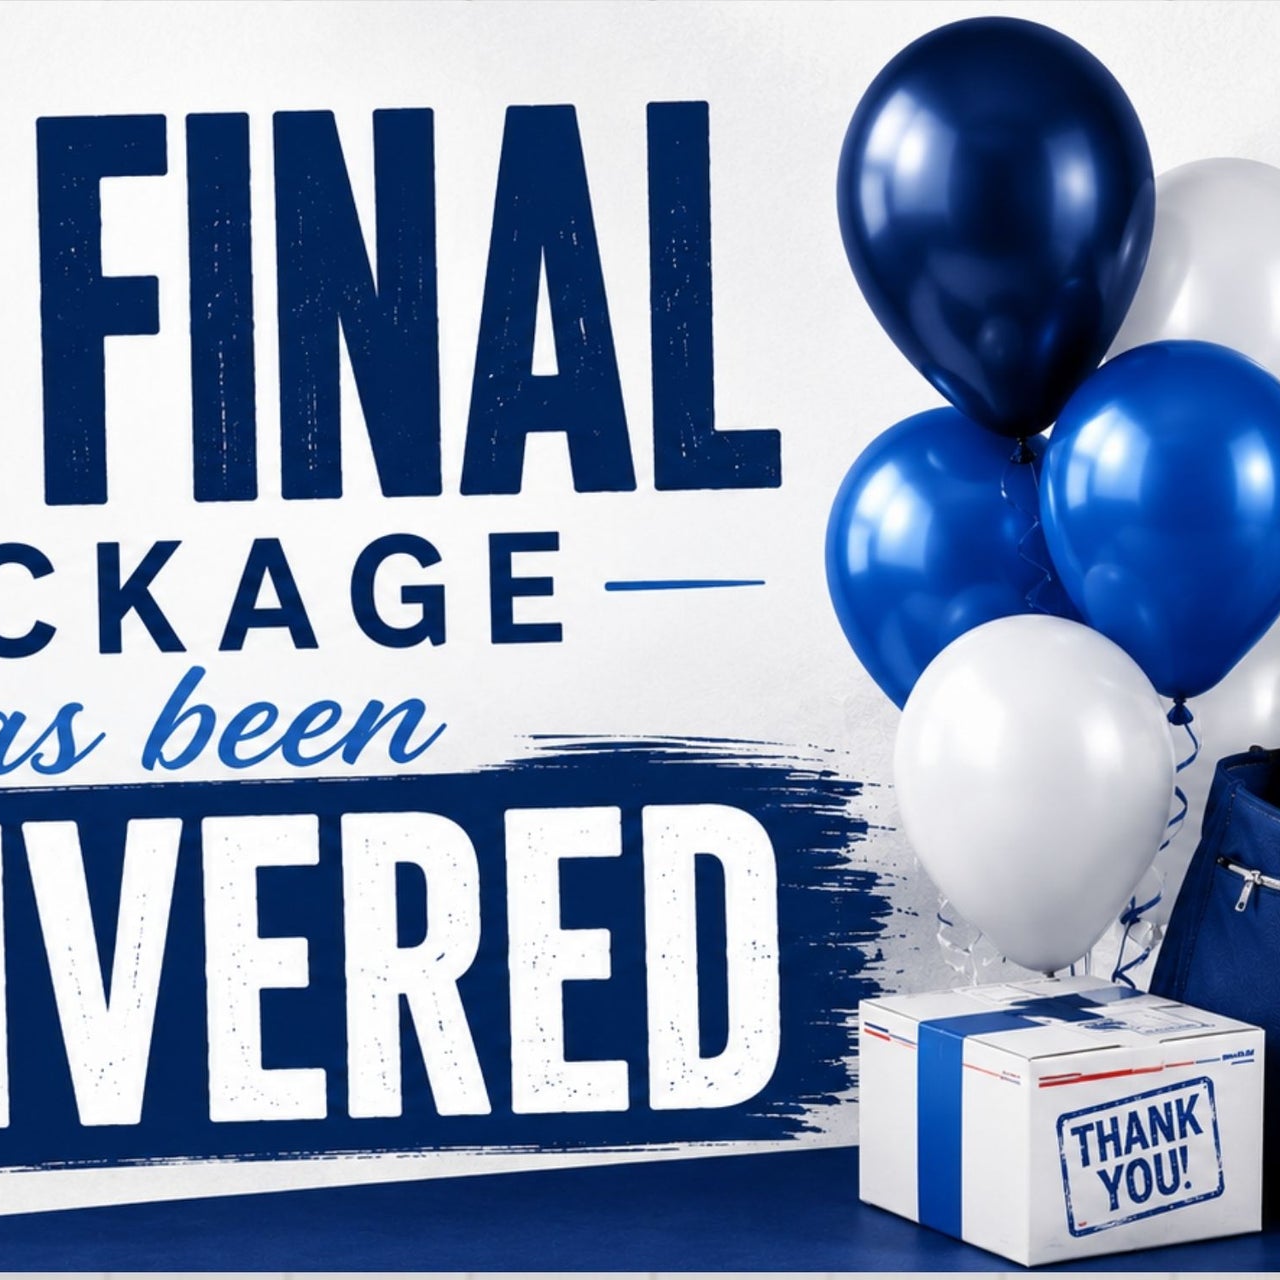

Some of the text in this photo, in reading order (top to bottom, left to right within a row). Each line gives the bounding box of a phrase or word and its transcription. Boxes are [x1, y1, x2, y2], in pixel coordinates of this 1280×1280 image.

[35, 100, 783, 507] FINAL
[141, 665, 447, 772] been
[1070, 1093, 1204, 1168] THANK
[1096, 1145, 1192, 1212] YOU!
